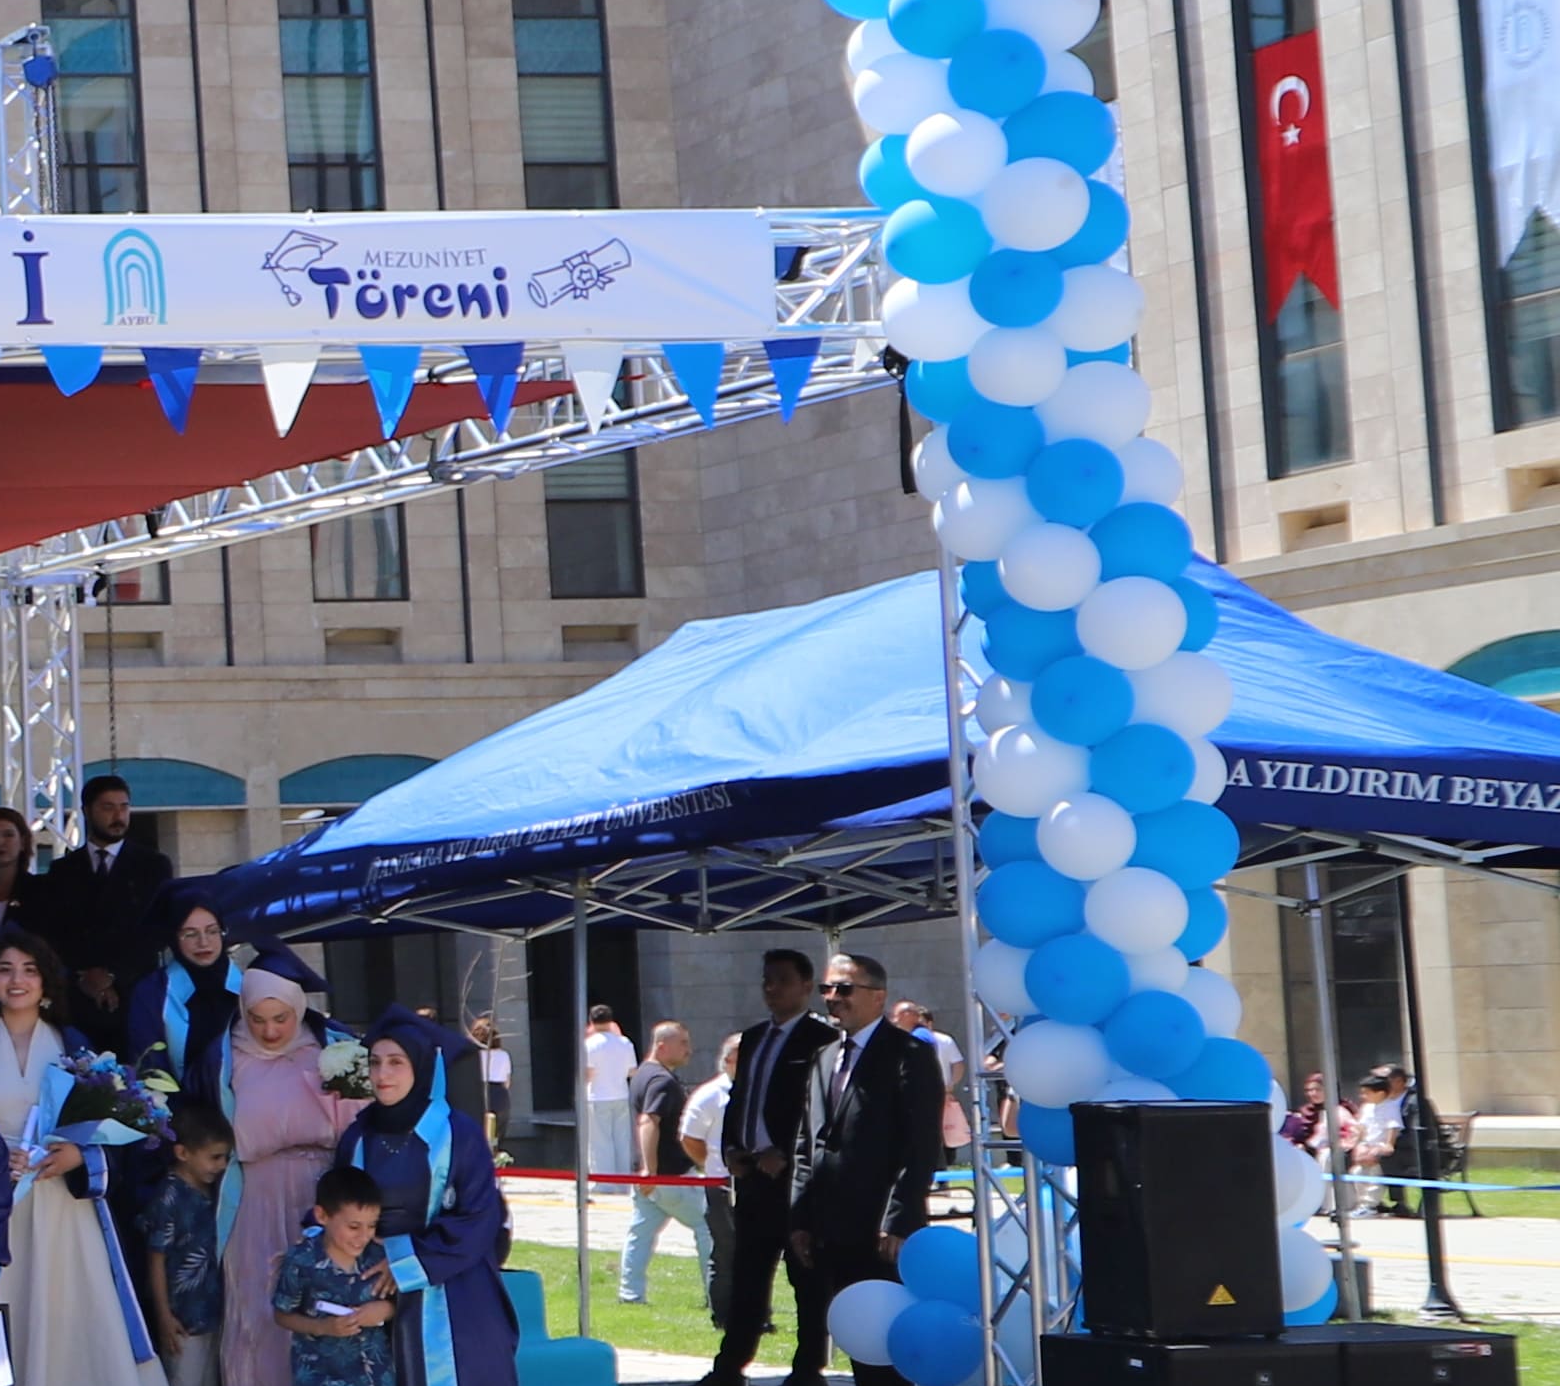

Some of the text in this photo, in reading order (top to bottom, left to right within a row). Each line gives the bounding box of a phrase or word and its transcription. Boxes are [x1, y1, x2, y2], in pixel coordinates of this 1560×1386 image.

[363, 247, 487, 270] MEZUNİYET
[307, 266, 512, 322] Töreni
[1257, 759, 1444, 803] YILDIRIM
